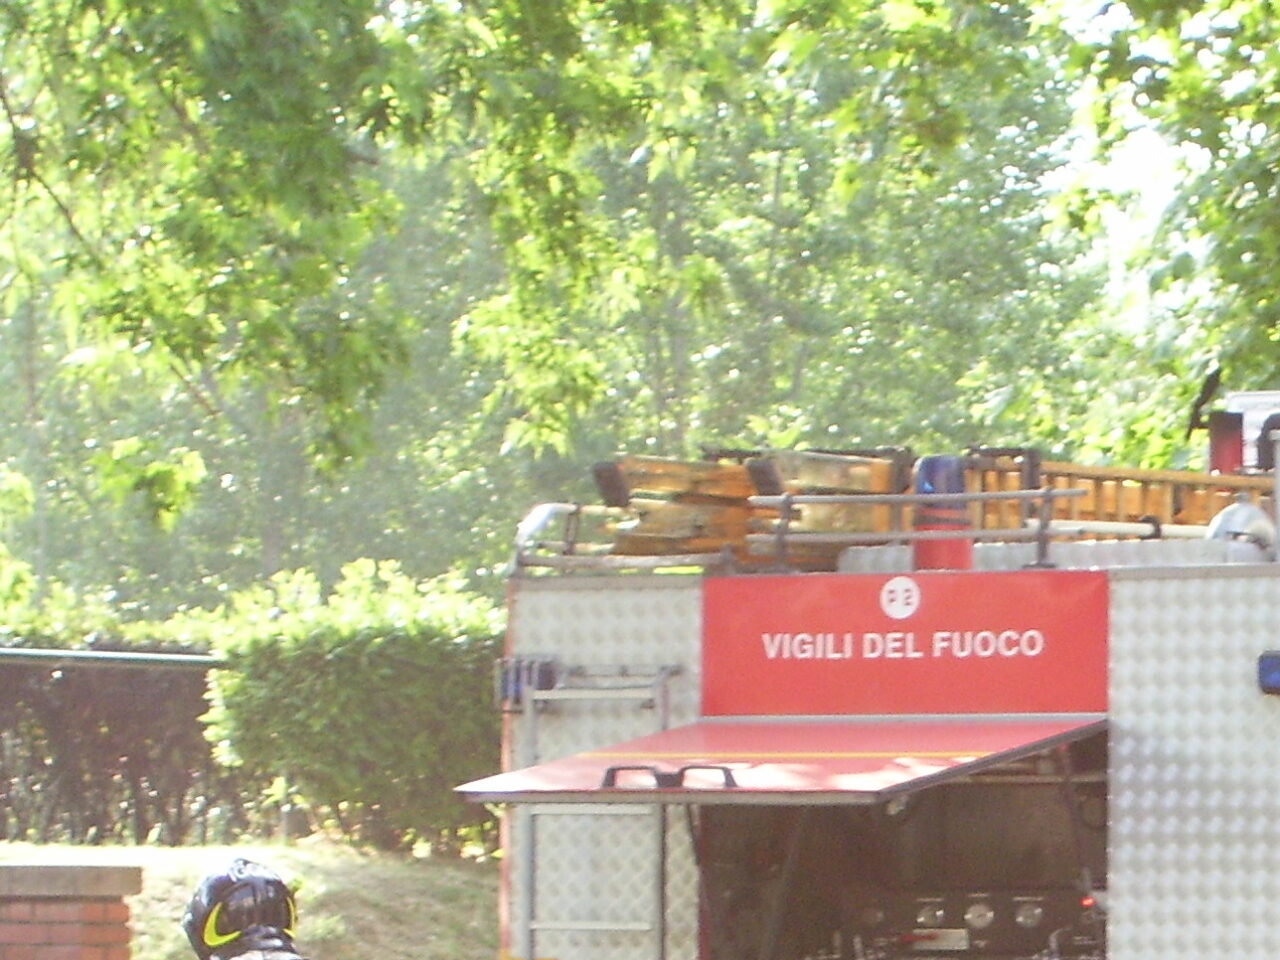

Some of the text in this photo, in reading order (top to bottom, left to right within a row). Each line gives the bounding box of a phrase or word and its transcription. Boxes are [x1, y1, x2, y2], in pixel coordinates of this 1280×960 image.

[761, 629, 1044, 659] VIGILI DEL FUOCO
